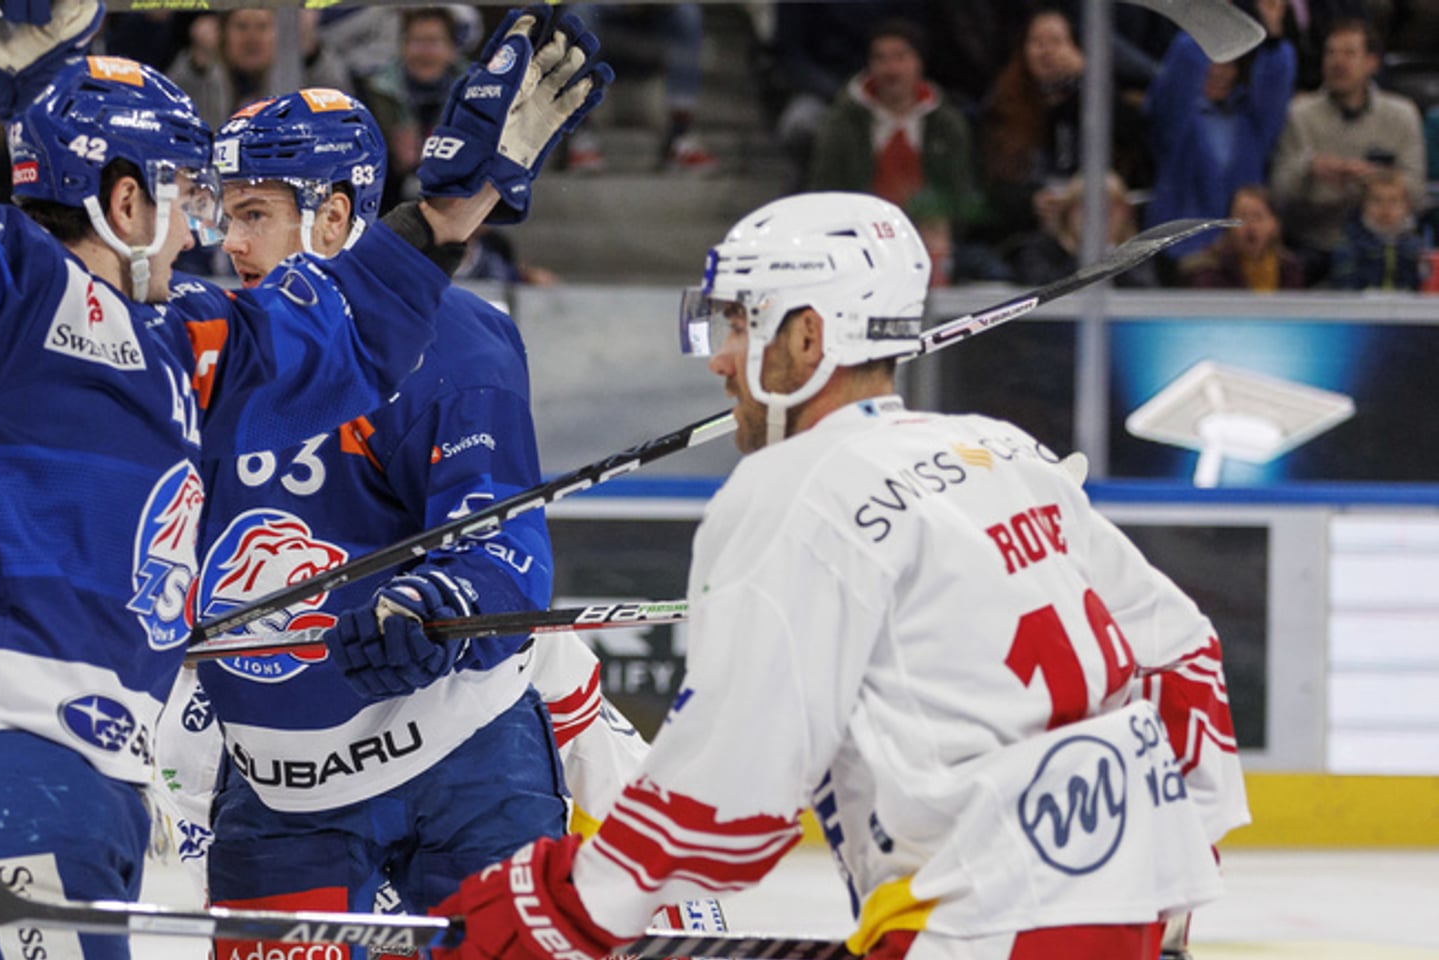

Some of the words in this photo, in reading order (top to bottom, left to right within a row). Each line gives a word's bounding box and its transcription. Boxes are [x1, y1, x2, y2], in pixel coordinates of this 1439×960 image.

[68, 134, 109, 162] 42
[351, 165, 375, 185] 83
[871, 222, 896, 240] 19
[232, 658, 284, 675] LIONS
[231, 721, 424, 790] SUBARU
[282, 924, 420, 950] ALPHA
